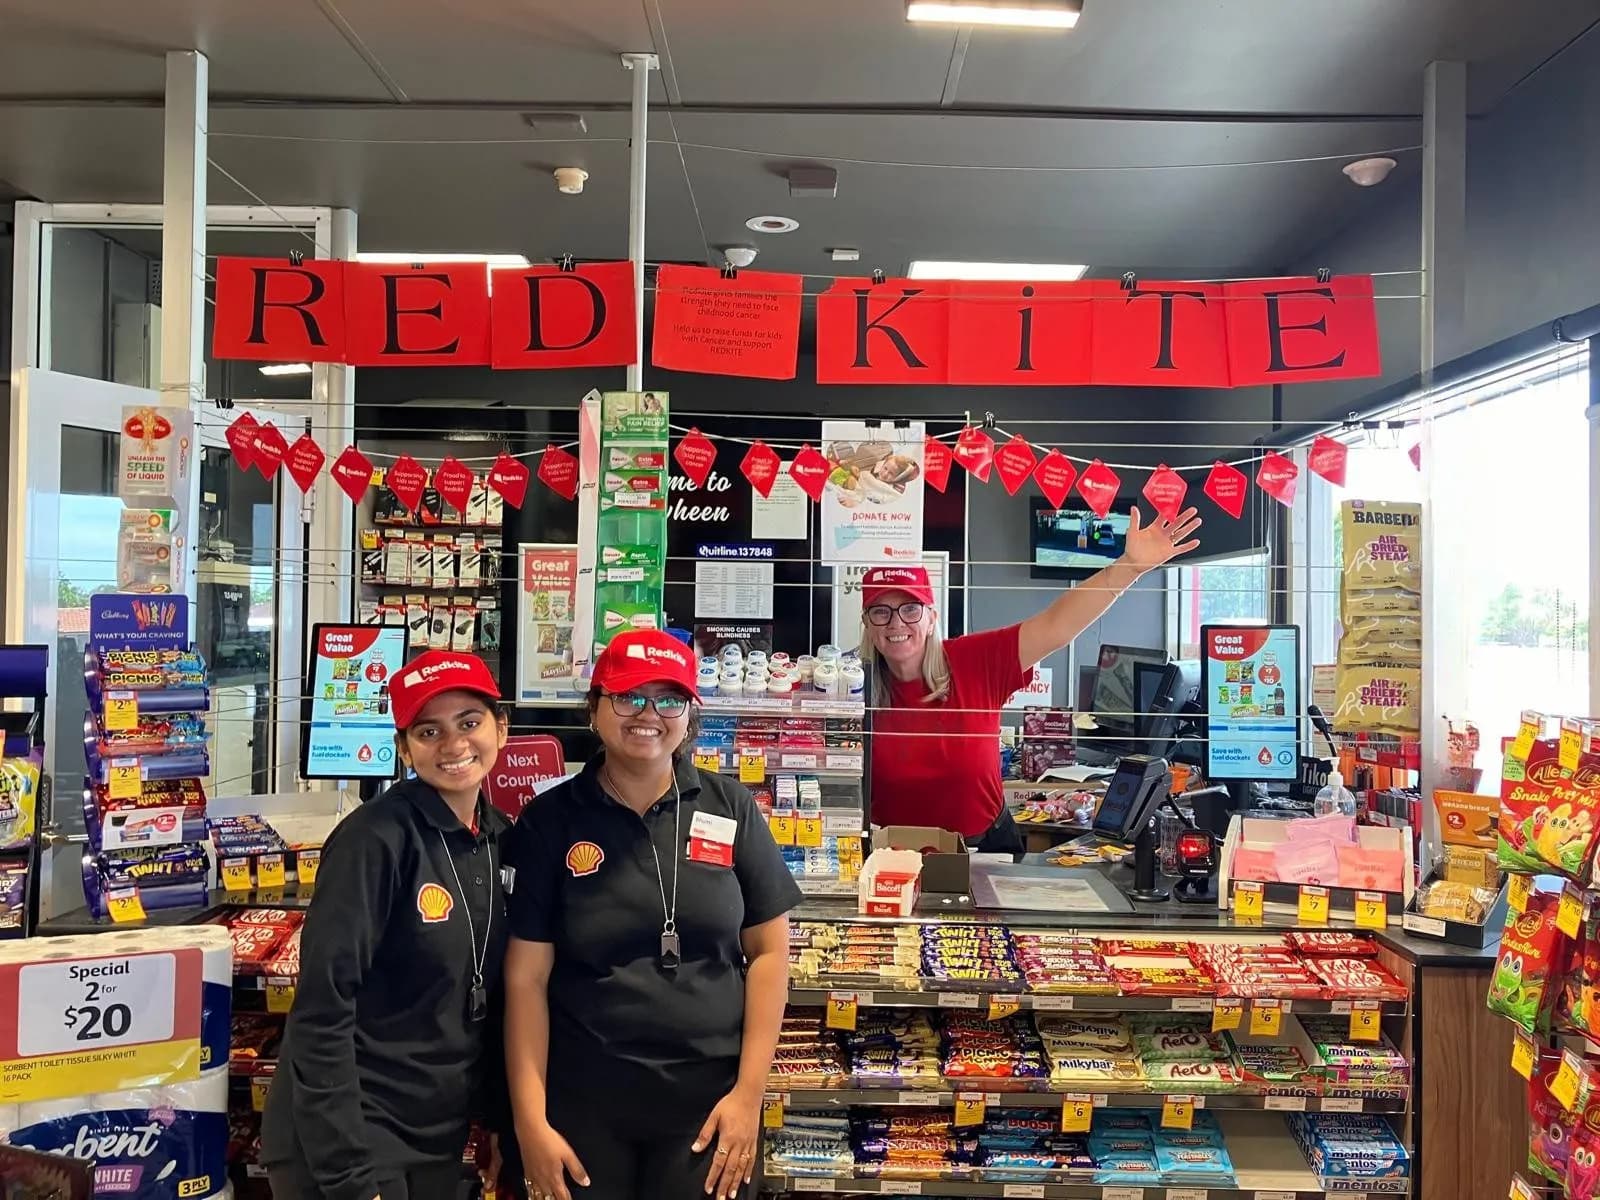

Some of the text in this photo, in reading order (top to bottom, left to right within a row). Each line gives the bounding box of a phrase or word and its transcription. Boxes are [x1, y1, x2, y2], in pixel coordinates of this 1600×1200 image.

[765, 293, 777, 301] the
[681, 297, 778, 311] strength they need to face
[245, 267, 607, 356] RED
[698, 307, 760, 319] childhood cancer
[673, 324, 690, 333] Help
[712, 327, 730, 336] raise
[732, 328, 752, 337] funds
[755, 330, 766, 338] for
[768, 331, 782, 340] kids
[682, 335, 772, 349] with Cancer and support
[710, 347, 743, 357] REDKITE
[127, 462, 165, 472] SPEED
[138, 473, 165, 481] LIQUID
[346, 468, 367, 477] Redkite
[394, 470, 424, 480] Supporting
[443, 471, 459, 479] Proud
[396, 477, 407, 485] kids
[444, 479, 465, 487] support
[707, 471, 731, 491] to
[444, 485, 464, 493] Redkite
[853, 512, 911, 521] DONATE NOW
[1378, 535, 1398, 544] AIR
[699, 545, 738, 557] Quitline
[1371, 543, 1408, 553] DRIED
[532, 559, 570, 572] Great
[532, 574, 571, 586] Value
[885, 569, 917, 581] Redkite
[325, 633, 353, 643] Great
[1215, 635, 1243, 644] Great
[325, 643, 354, 653] Value
[1215, 645, 1244, 655] Value
[647, 646, 687, 667] Redkite
[421, 660, 471, 677] Redkite
[111, 674, 162, 684] PICNIC
[1370, 678, 1389, 688] AIR
[849, 741, 857, 751] 5
[507, 753, 540, 767] Next
[1302, 763, 1327, 787] Tiko
[877, 883, 901, 893] Biscoff
[69, 960, 130, 981] Special
[85, 982, 118, 1002] 2 for
[64, 1003, 132, 1041] $20
[1261, 1013, 1271, 1022] $6
[1360, 1015, 1370, 1025] $6
[962, 1048, 1010, 1057] PICNIC
[1328, 1048, 1370, 1057] mentos
[3, 1050, 137, 1072] SORBENT TOILET TISSUE SILKY WHITE
[1058, 1059, 1113, 1070] Milkybar
[1170, 1064, 1212, 1078] Aero
[11, 1072, 32, 1082] PACK
[1332, 1088, 1401, 1099] mentos
[1073, 1107, 1083, 1117] $6
[1007, 1119, 1055, 1130] BOOST
[785, 1140, 839, 1148] BOUNTY
[785, 1149, 842, 1158] BOUNTY
[182, 1177, 208, 1194] 3 PLY
[1332, 1180, 1401, 1192] mentos
